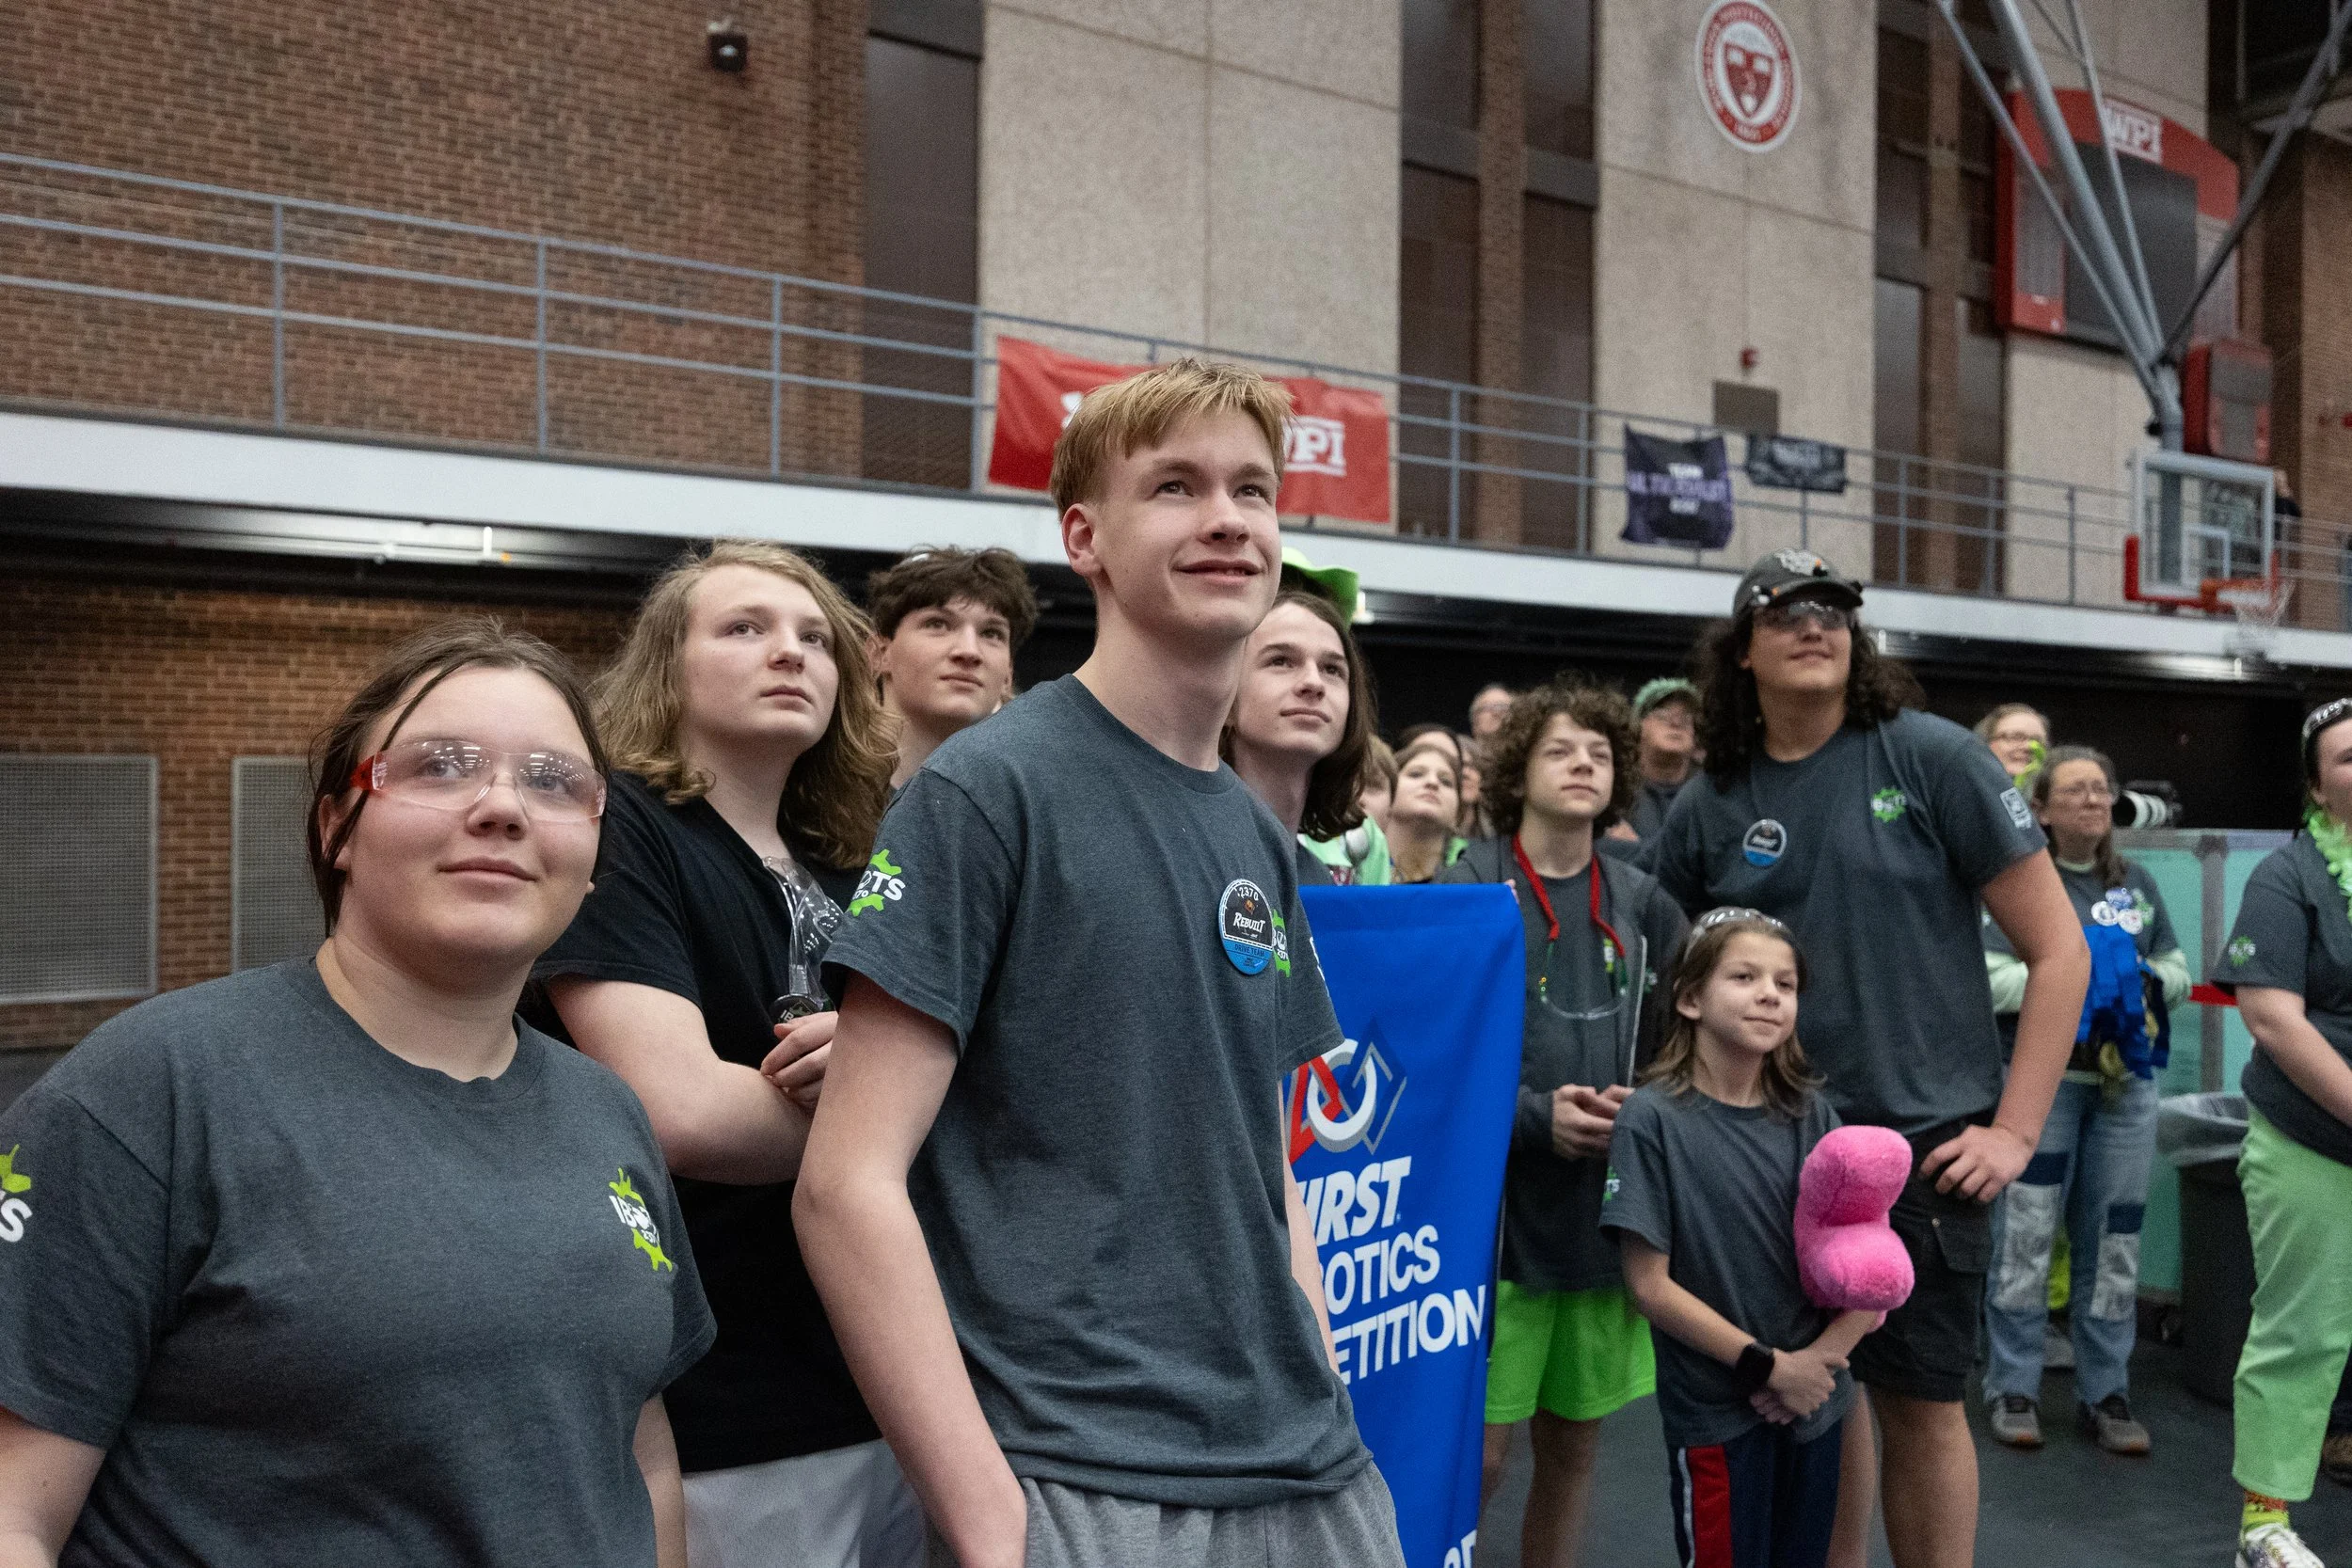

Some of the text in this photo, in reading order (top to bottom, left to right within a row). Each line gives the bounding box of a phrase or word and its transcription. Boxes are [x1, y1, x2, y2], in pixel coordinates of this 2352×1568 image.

[1234, 943, 1264, 957] DRIVE TEAM
[1296, 1155, 1412, 1247] IRST
[1319, 1225, 1440, 1315] OTICS
